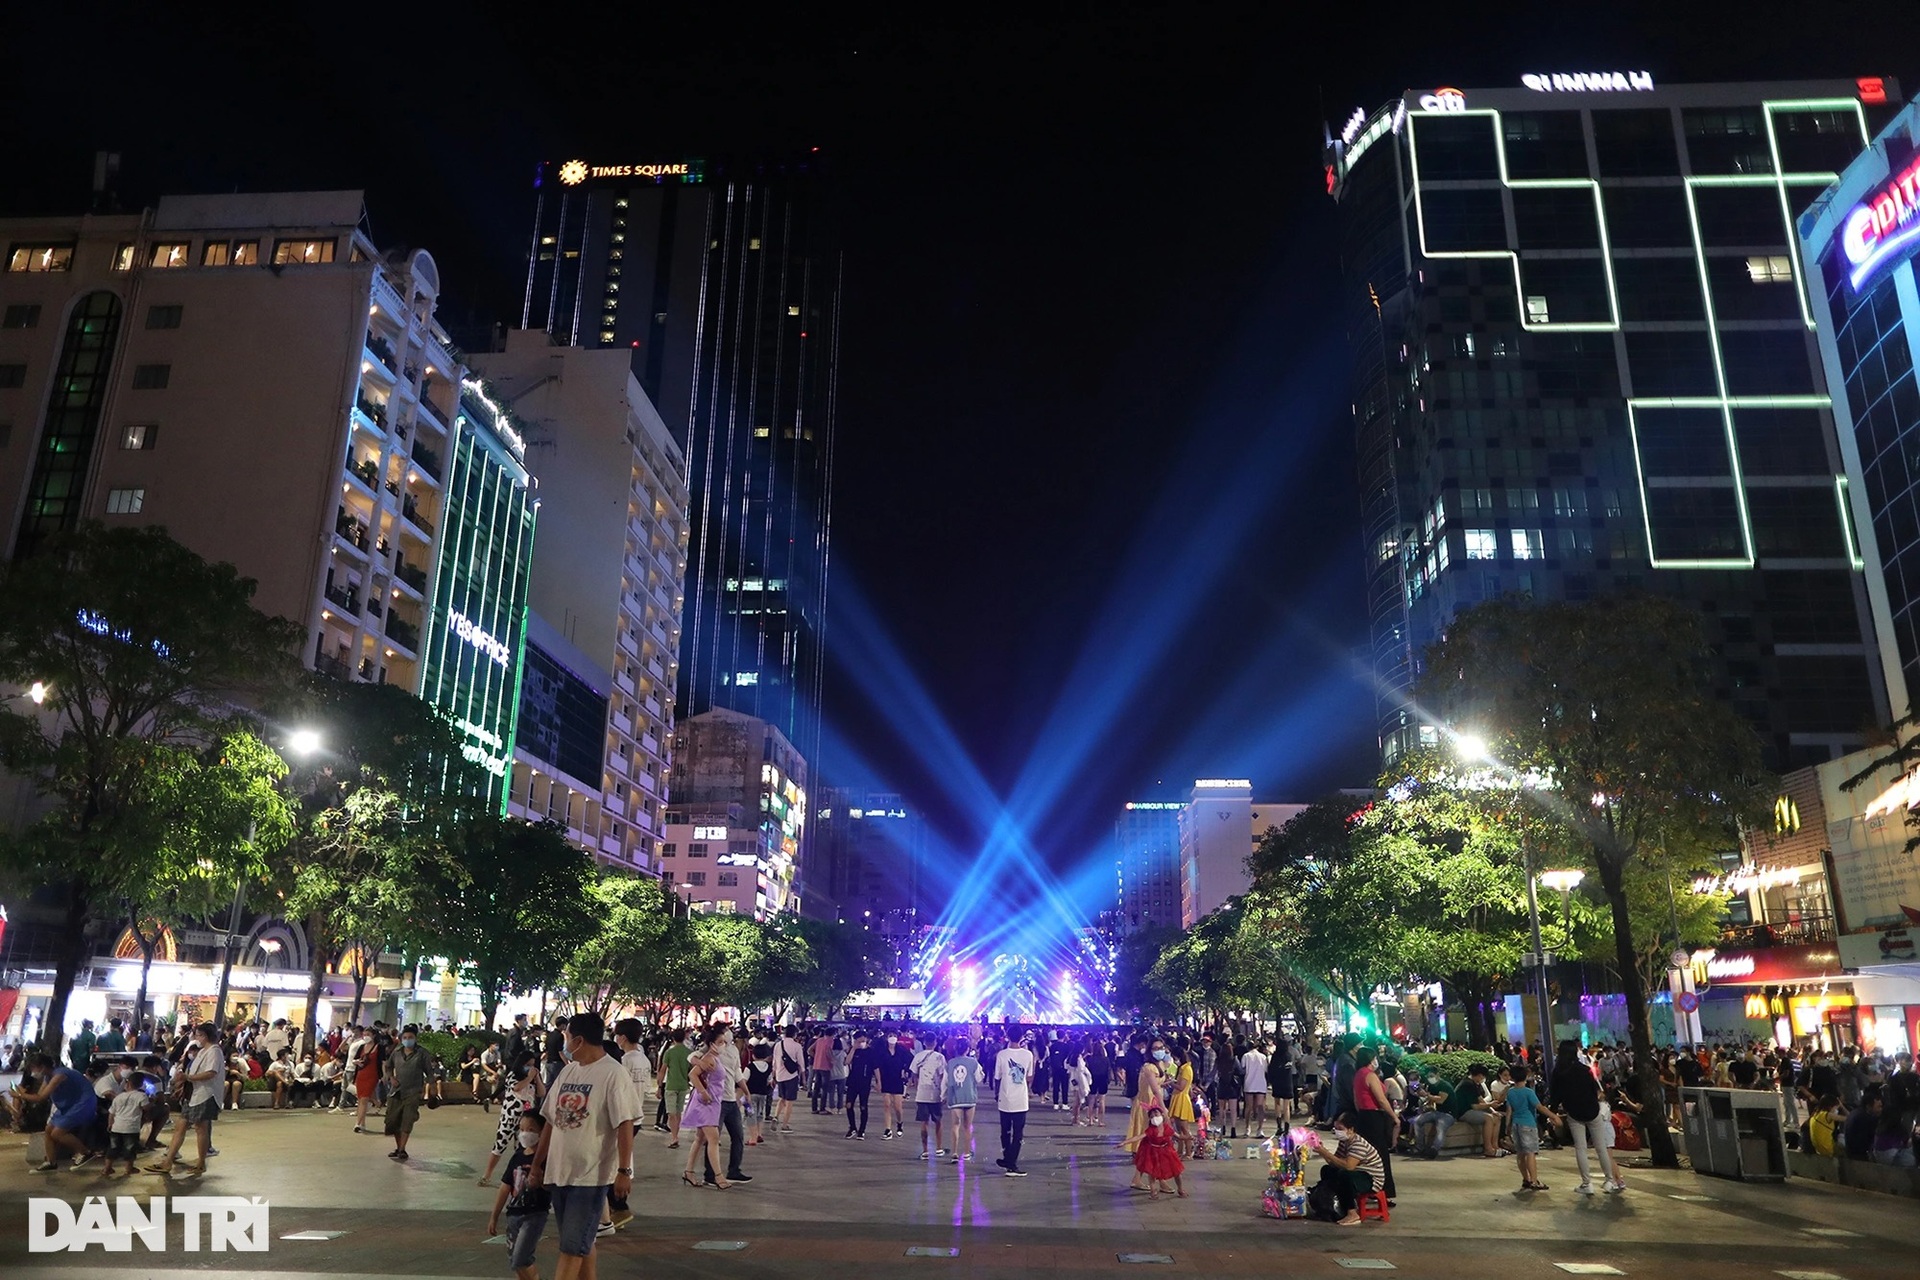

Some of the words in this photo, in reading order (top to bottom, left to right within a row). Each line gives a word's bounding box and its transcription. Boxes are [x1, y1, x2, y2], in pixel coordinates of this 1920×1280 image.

[592, 166, 631, 177] TIMES
[634, 164, 688, 177] SQUARE
[561, 1084, 591, 1093] GUCCI
